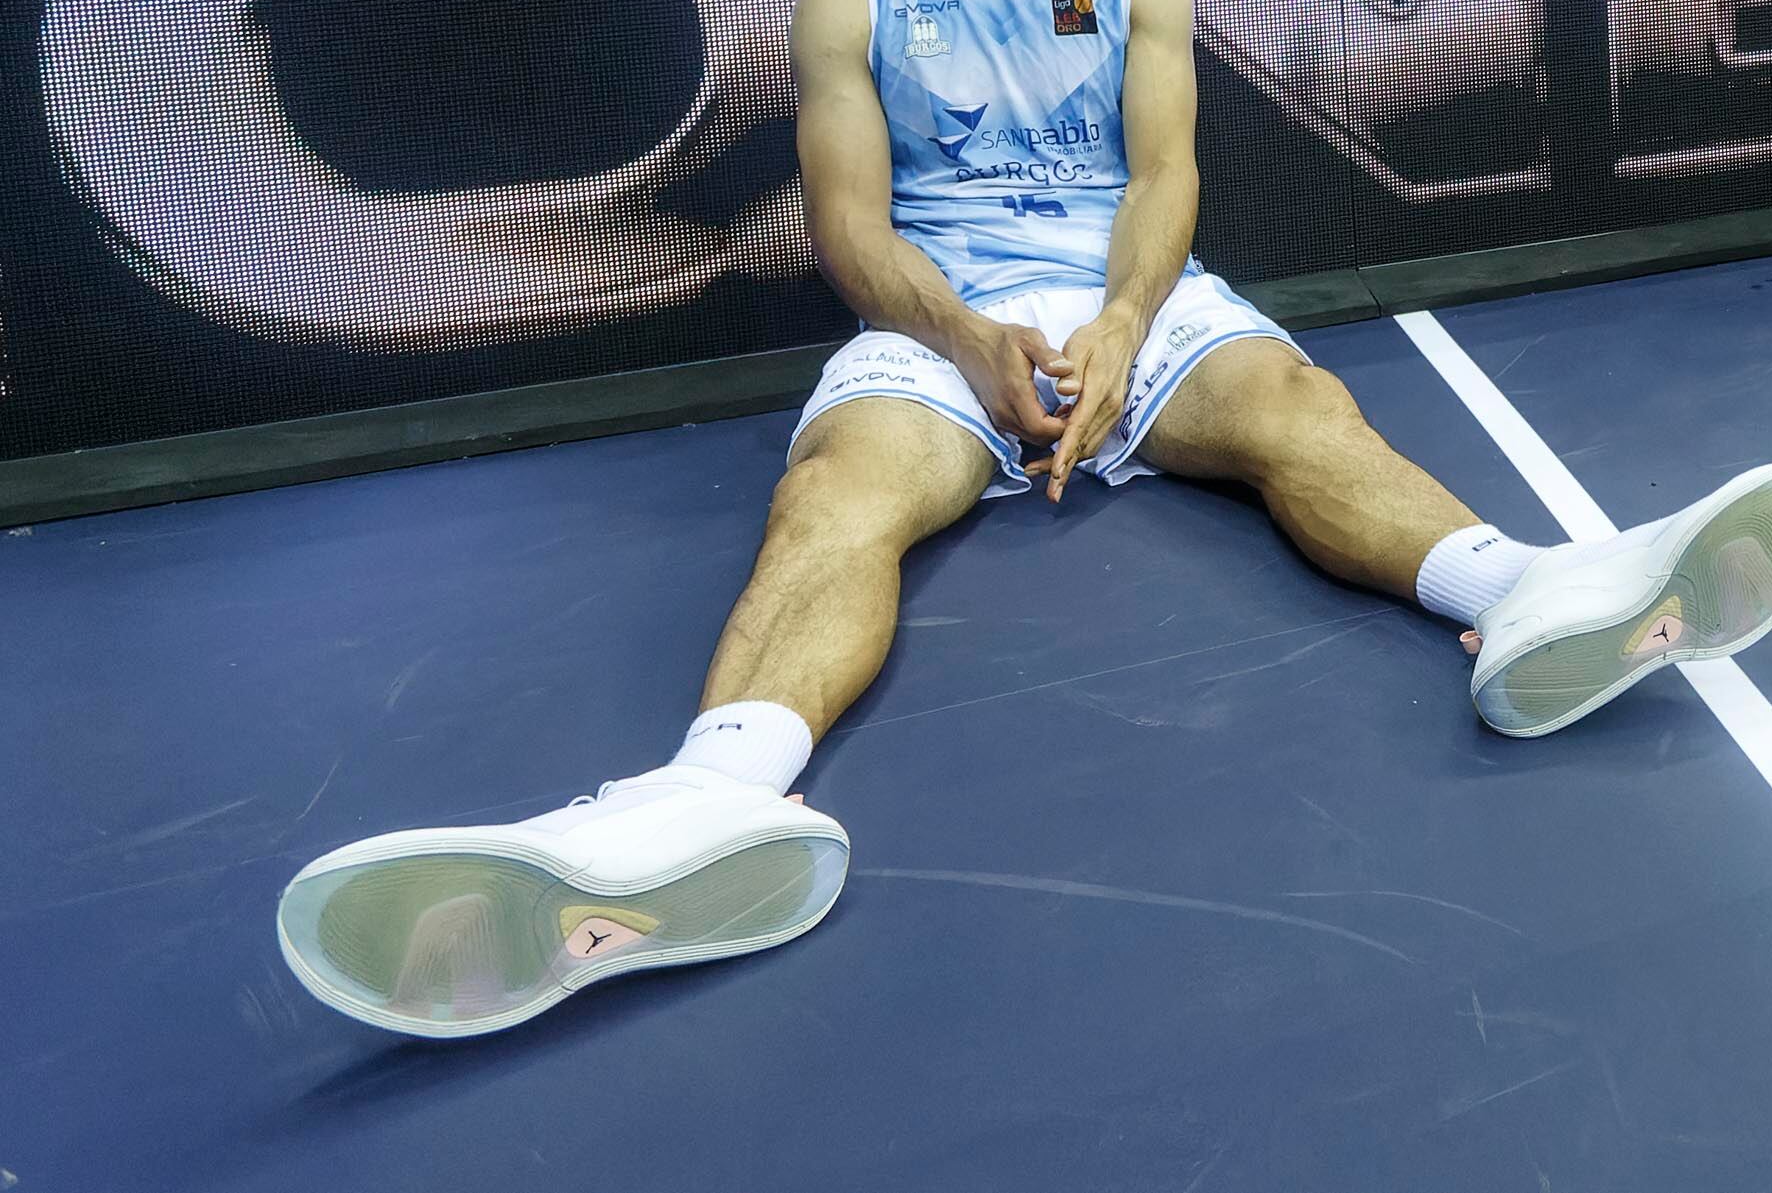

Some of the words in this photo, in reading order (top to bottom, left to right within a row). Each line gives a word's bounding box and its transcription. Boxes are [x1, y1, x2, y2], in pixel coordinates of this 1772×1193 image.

[1053, 0, 1071, 10] Liga
[1055, 12, 1081, 25] LEB
[1056, 23, 1082, 34] ORO
